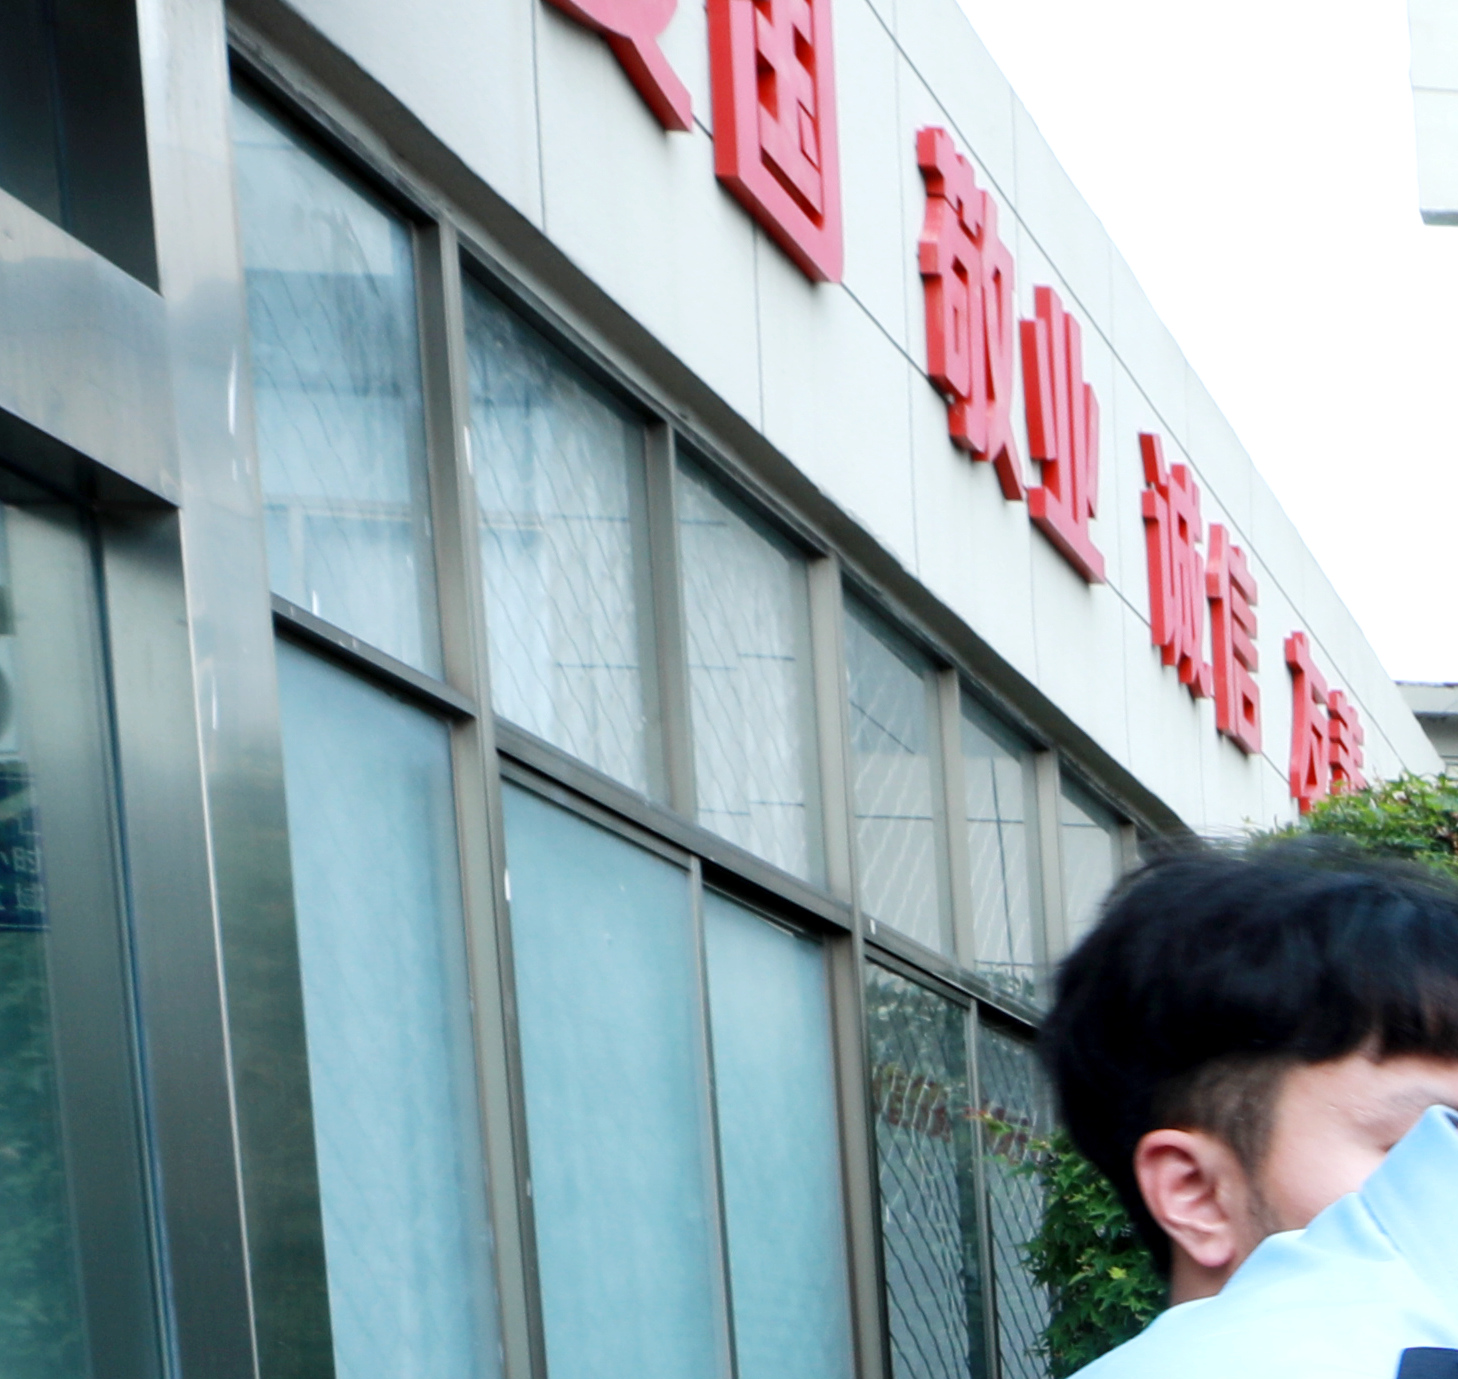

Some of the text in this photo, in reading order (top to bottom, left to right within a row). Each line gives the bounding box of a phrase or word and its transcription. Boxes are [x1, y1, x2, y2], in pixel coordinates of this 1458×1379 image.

[540, 0, 844, 283] 国
[917, 126, 1105, 584] 敬业
[1138, 431, 1262, 755] 诚信
